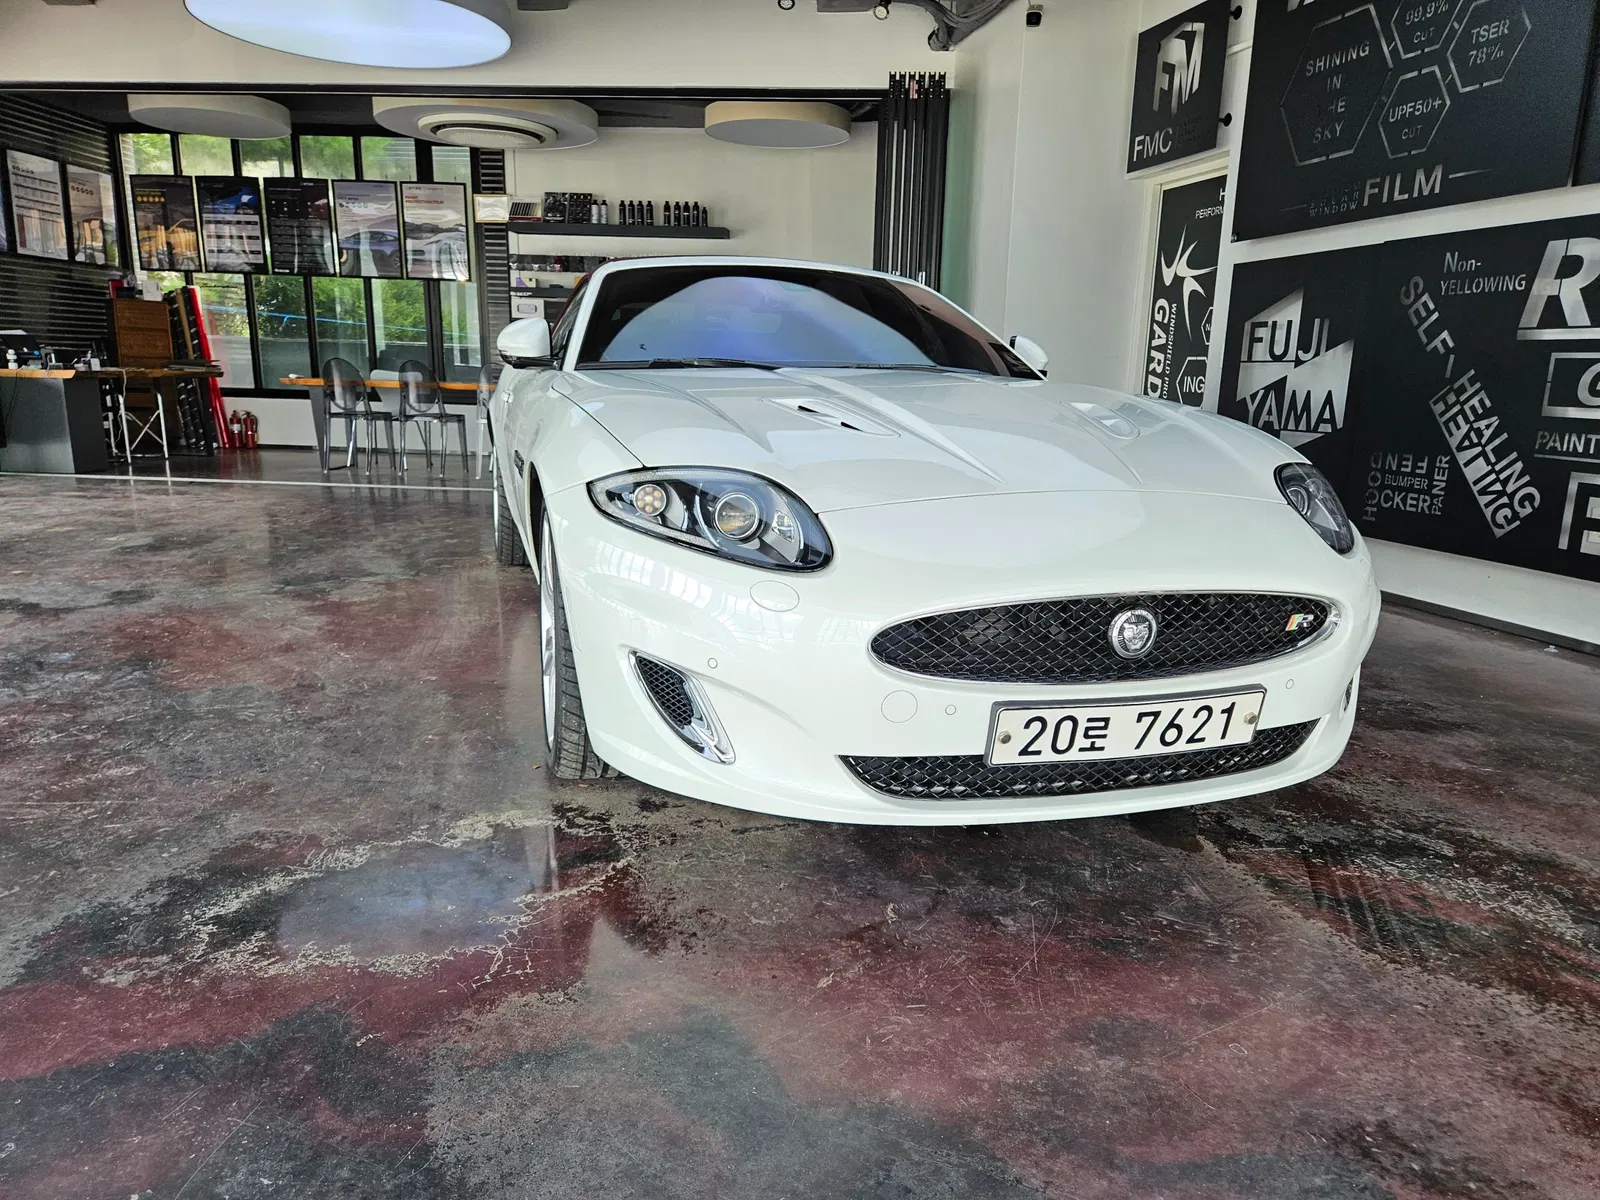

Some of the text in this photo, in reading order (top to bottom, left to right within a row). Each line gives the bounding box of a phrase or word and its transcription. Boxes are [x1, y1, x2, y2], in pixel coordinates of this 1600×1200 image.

[1405, 0, 1449, 25] 99.9%
[1413, 27, 1436, 43] CUT
[1471, 19, 1510, 44] TSER
[1305, 42, 1370, 77] SHINING
[1468, 43, 1504, 67] 78%
[1326, 74, 1343, 91] IN
[1388, 97, 1443, 122] UPF50+
[1133, 127, 1173, 162] FMC
[1313, 120, 1345, 144] SKY
[1401, 125, 1423, 140] CUT
[1362, 164, 1443, 207] FILM
[1309, 200, 1359, 217] WINDOW
[1440, 274, 1527, 297] YELLOWING
[1165, 303, 1178, 374] WINDSHIELD
[1248, 318, 1330, 362] FUJI
[1245, 389, 1339, 433] YAMA
[1535, 430, 1600, 455] PAINT
[1384, 474, 1429, 490] BUMPER
[1017, 701, 1237, 758] 20로 7621
